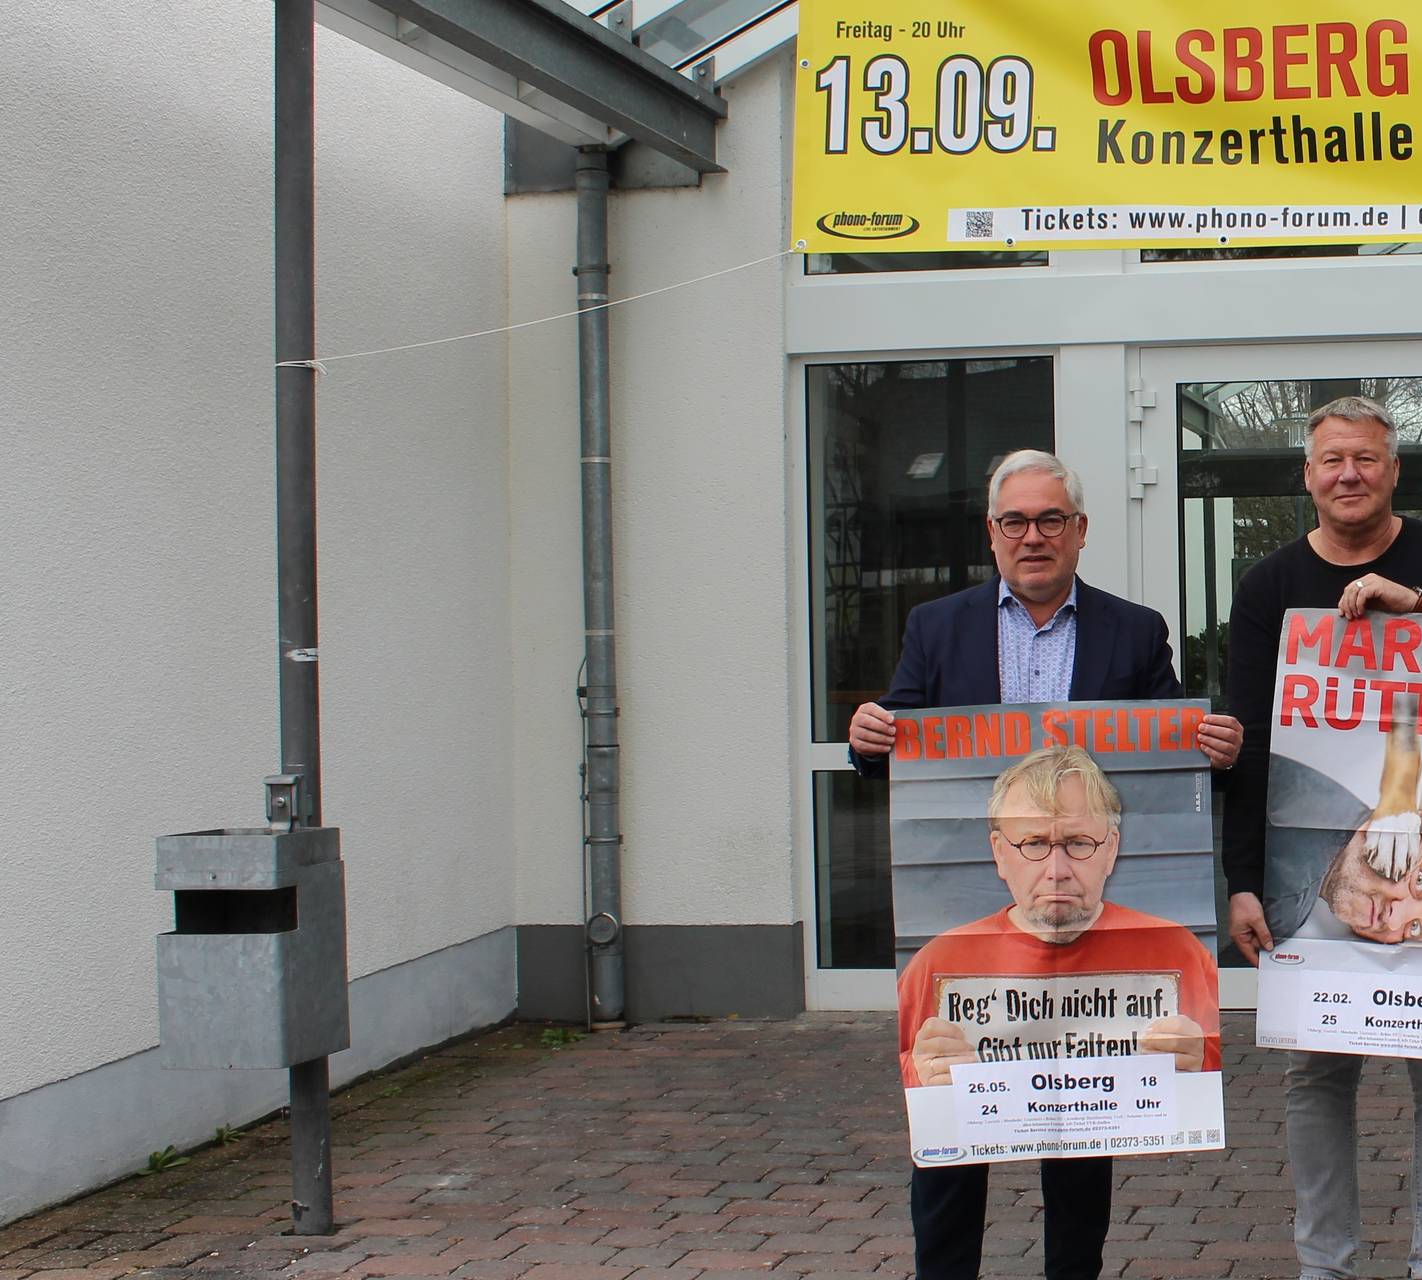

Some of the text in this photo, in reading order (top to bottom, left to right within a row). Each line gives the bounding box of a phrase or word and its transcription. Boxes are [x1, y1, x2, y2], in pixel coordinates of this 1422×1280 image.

[836, 21, 893, 41] Freitag
[912, 21, 931, 38] 20
[937, 21, 966, 38] Uhr
[1088, 19, 1411, 106] OLSBERG
[815, 53, 1057, 156] 13.09.
[1097, 111, 1414, 164] Konzerthalle
[832, 211, 903, 228] phono-forum
[1021, 207, 1118, 231] Tickets:
[1129, 206, 1389, 233] www.phono-forum.de
[894, 707, 1206, 761] BERND STELTER
[1006, 988, 1054, 1021] Dich
[1061, 987, 1118, 1018] nicht
[1126, 988, 1169, 1019] auf.
[1313, 992, 1352, 1004] 22.02.
[1321, 1014, 1337, 1025] 25
[977, 1037, 1022, 1063] Gibt
[1027, 1038, 1062, 1061] nur
[969, 1074, 1157, 1093] 26.05. Olsberg 18
[981, 1099, 1161, 1115] 24 Konzerthalle Uhr
[970, 1144, 1008, 1156] Tickets:
[1010, 1138, 1101, 1155] www.phono-forum.de
[1110, 1136, 1165, 1148] 02373-5351
